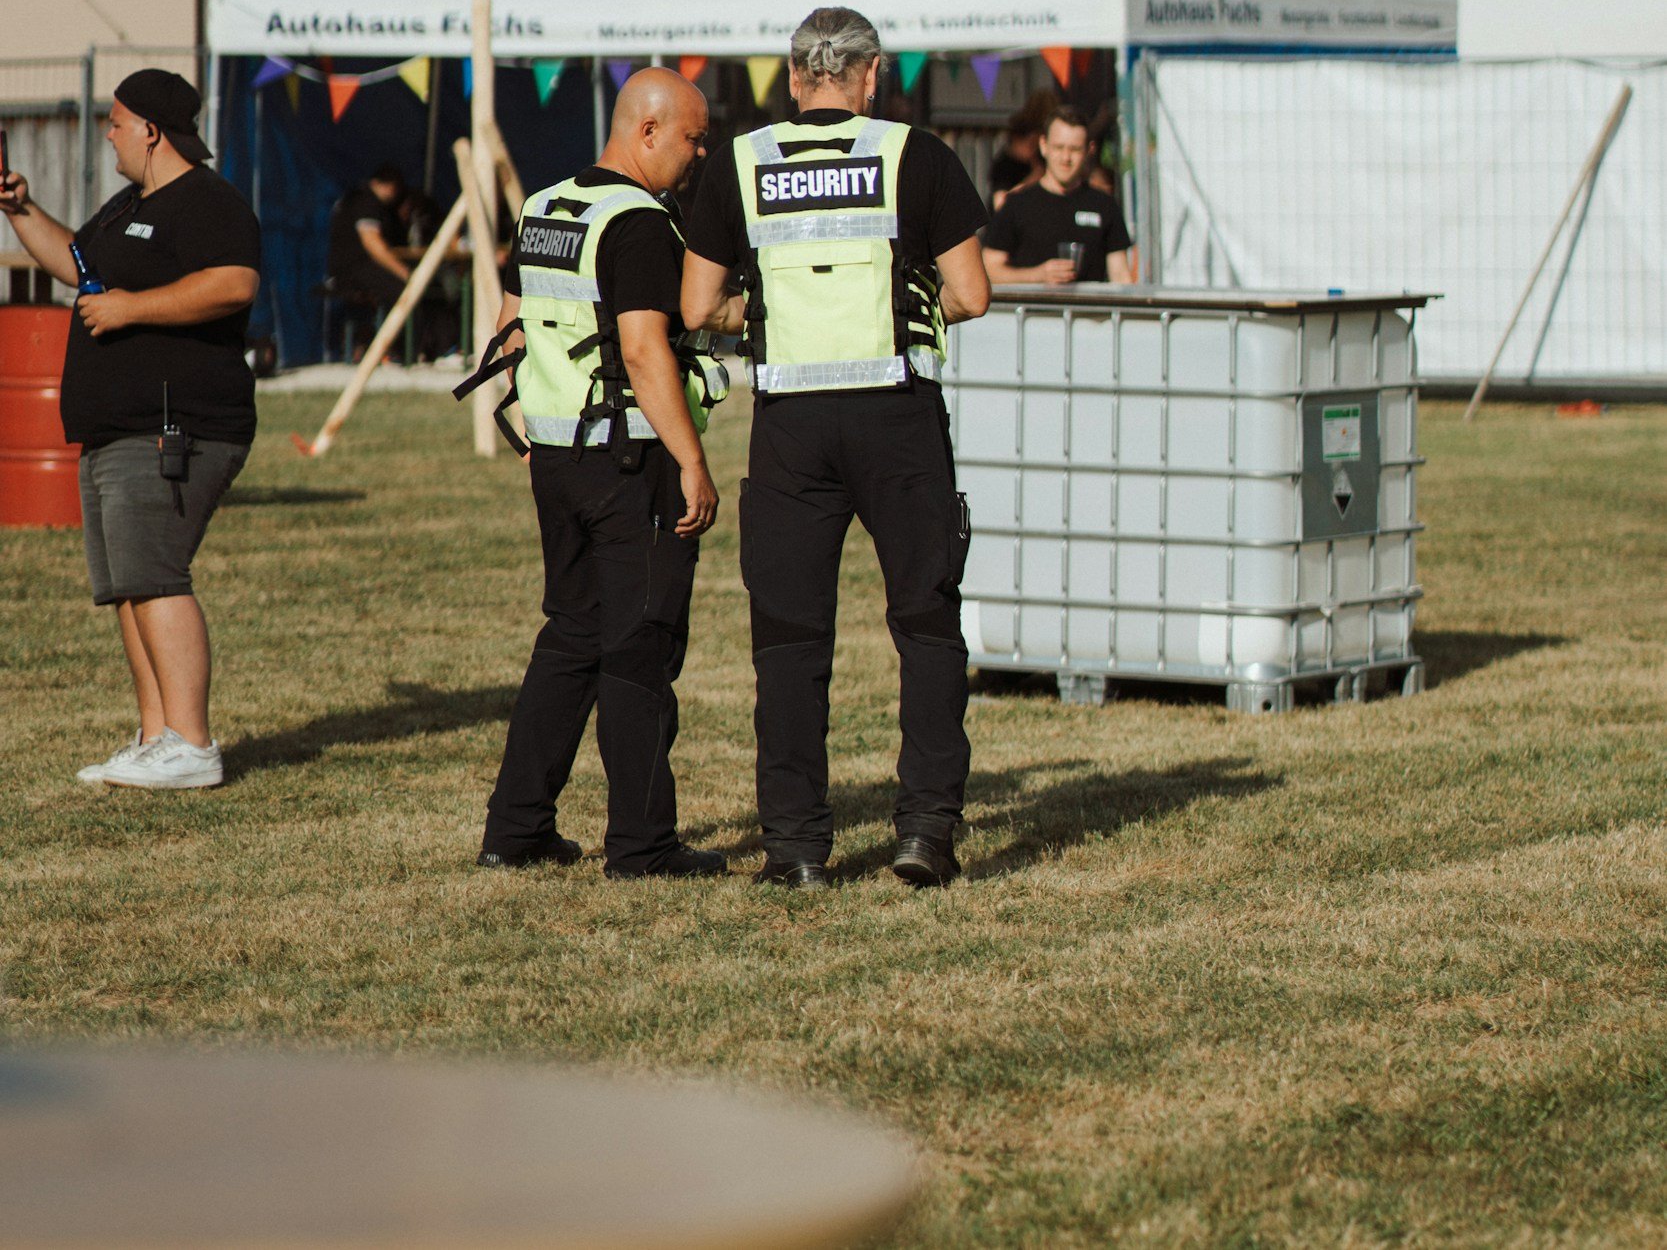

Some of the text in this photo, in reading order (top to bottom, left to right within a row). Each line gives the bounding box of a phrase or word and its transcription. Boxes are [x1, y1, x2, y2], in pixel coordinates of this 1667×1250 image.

[266, 10, 426, 35] Autohaus
[760, 166, 878, 202] SECURITY
[520, 226, 583, 259] SECURITY
